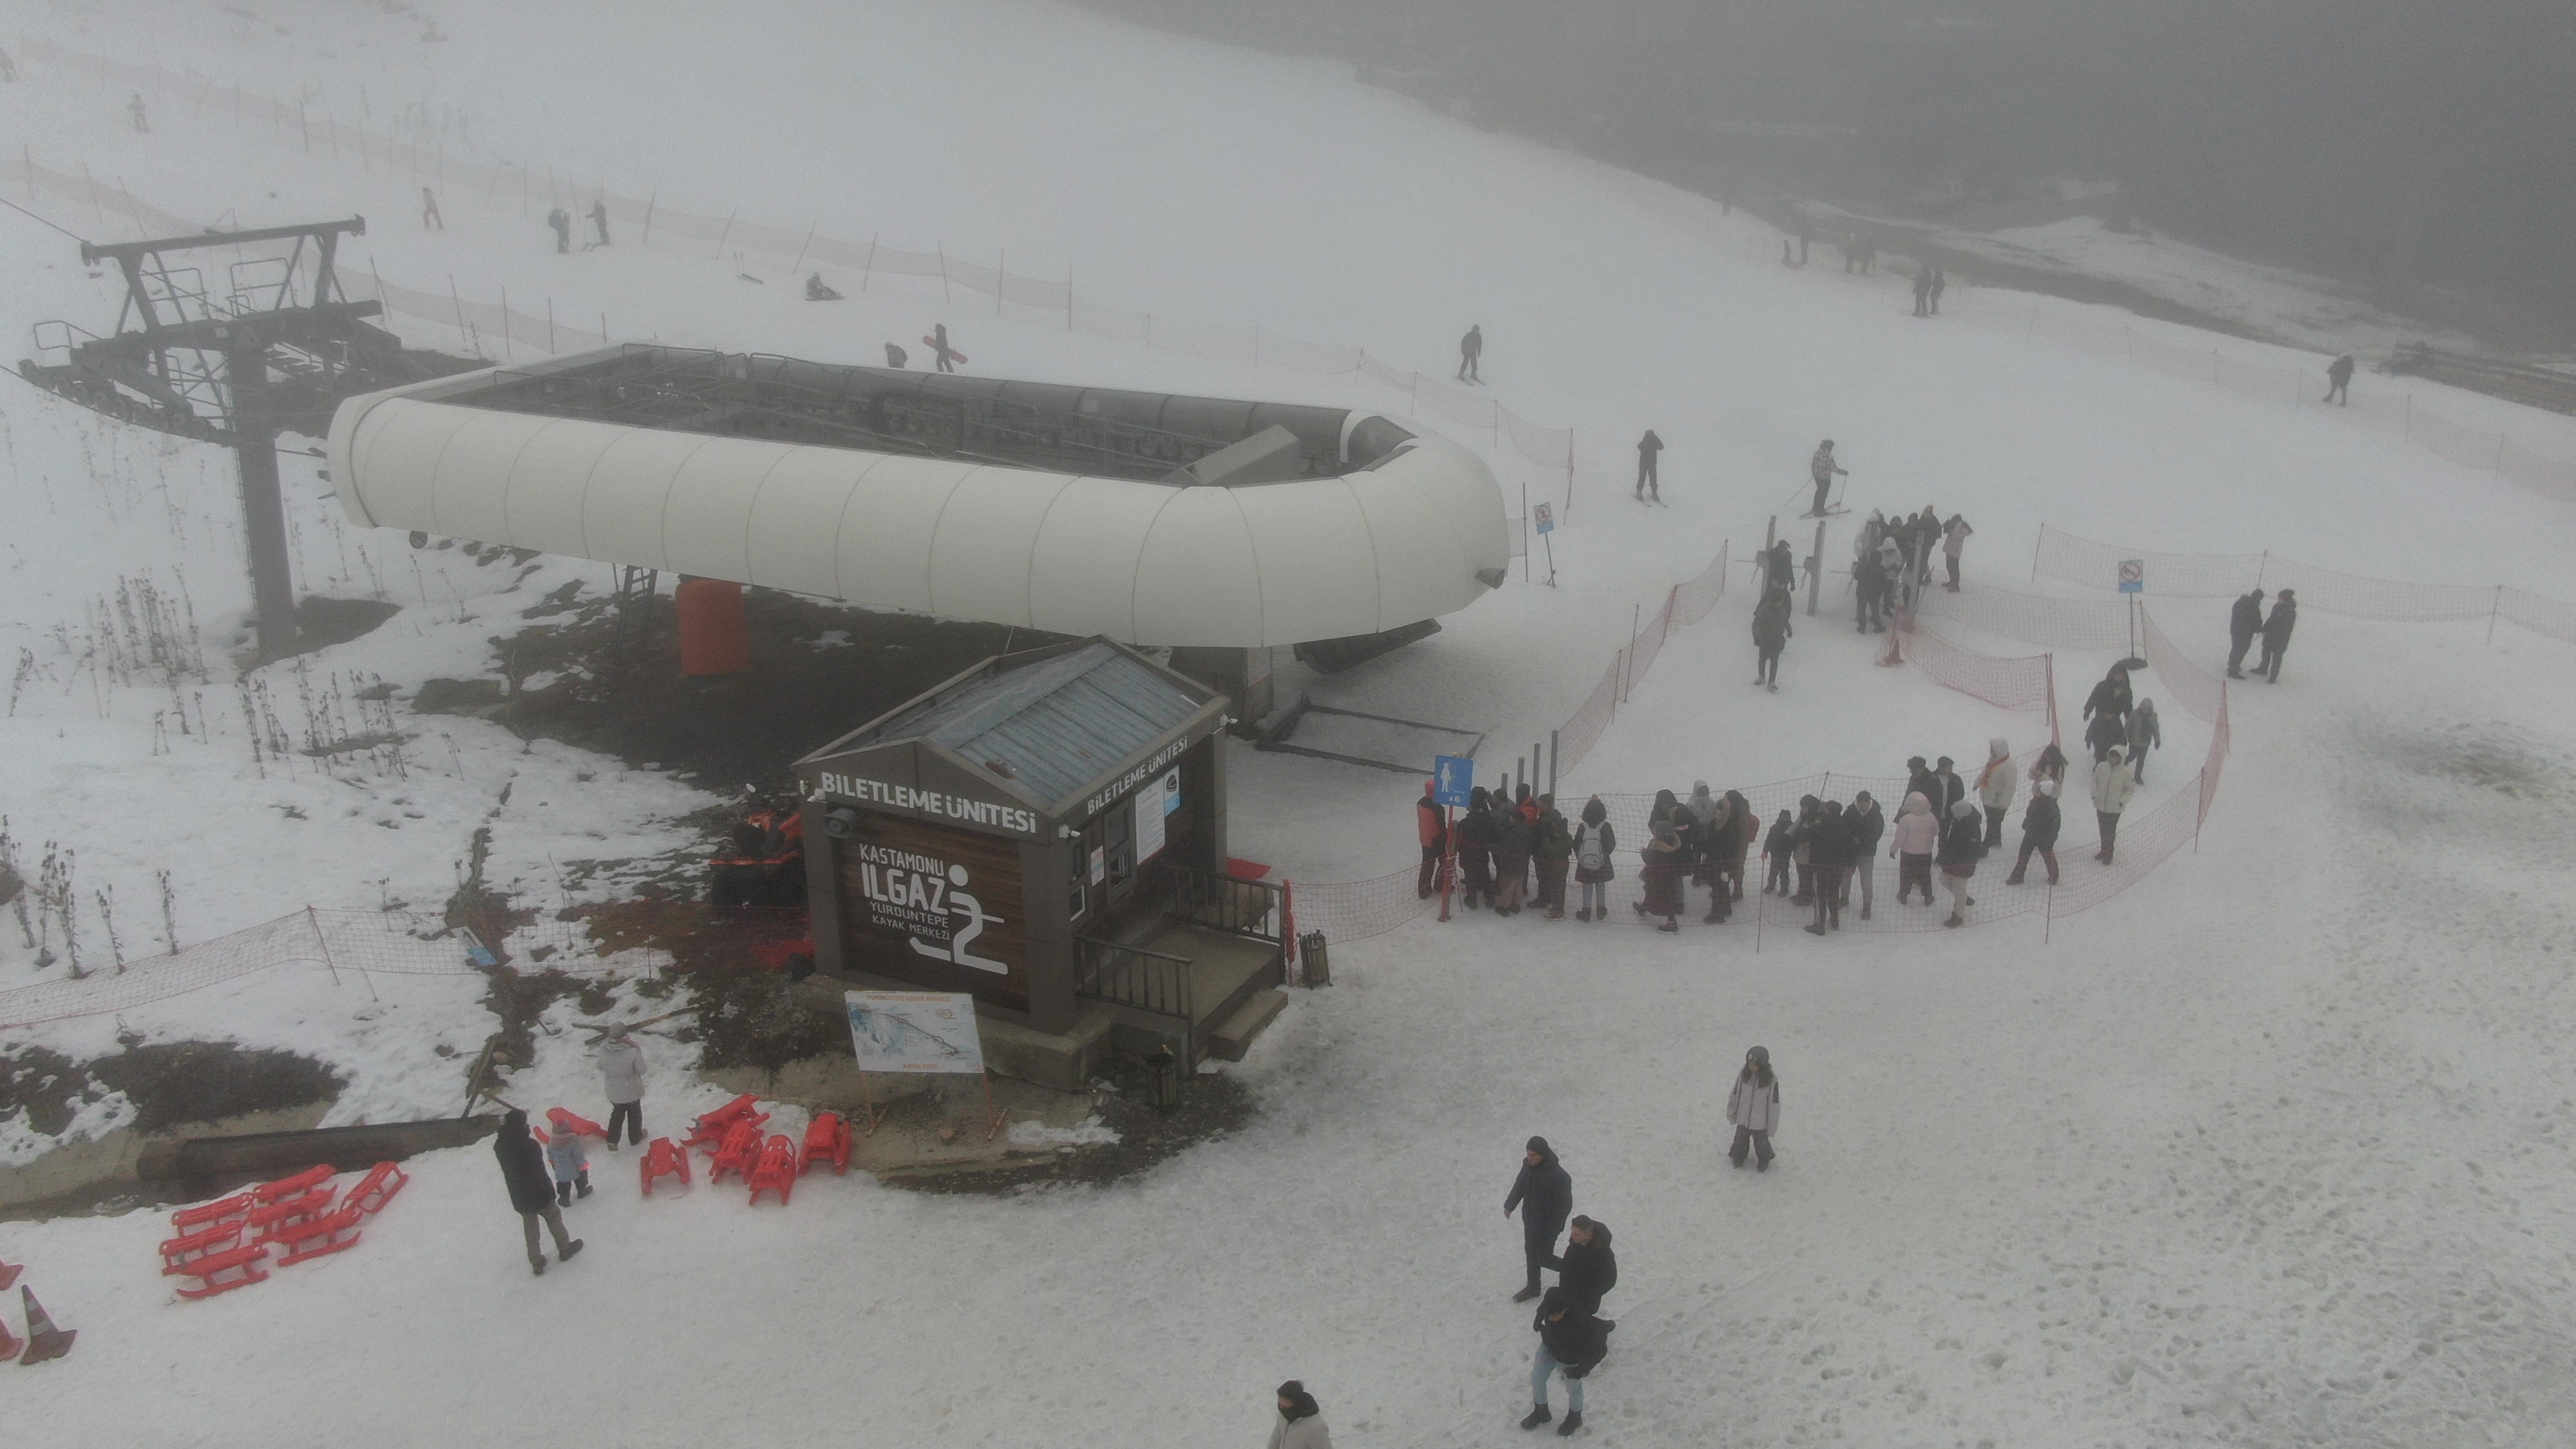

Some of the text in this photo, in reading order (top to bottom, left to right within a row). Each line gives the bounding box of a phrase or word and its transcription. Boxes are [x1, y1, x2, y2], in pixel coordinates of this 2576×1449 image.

[821, 772, 1036, 833] BİLETLEME ÜNİTESİ
[1088, 764, 1146, 815] BİLETLEME
[859, 843, 944, 876] KASTAMONU
[861, 862, 949, 916] ILGAZ
[869, 902, 949, 928] YURDUNTEPE
[872, 914, 950, 941] KAYAK MERKEZİ
